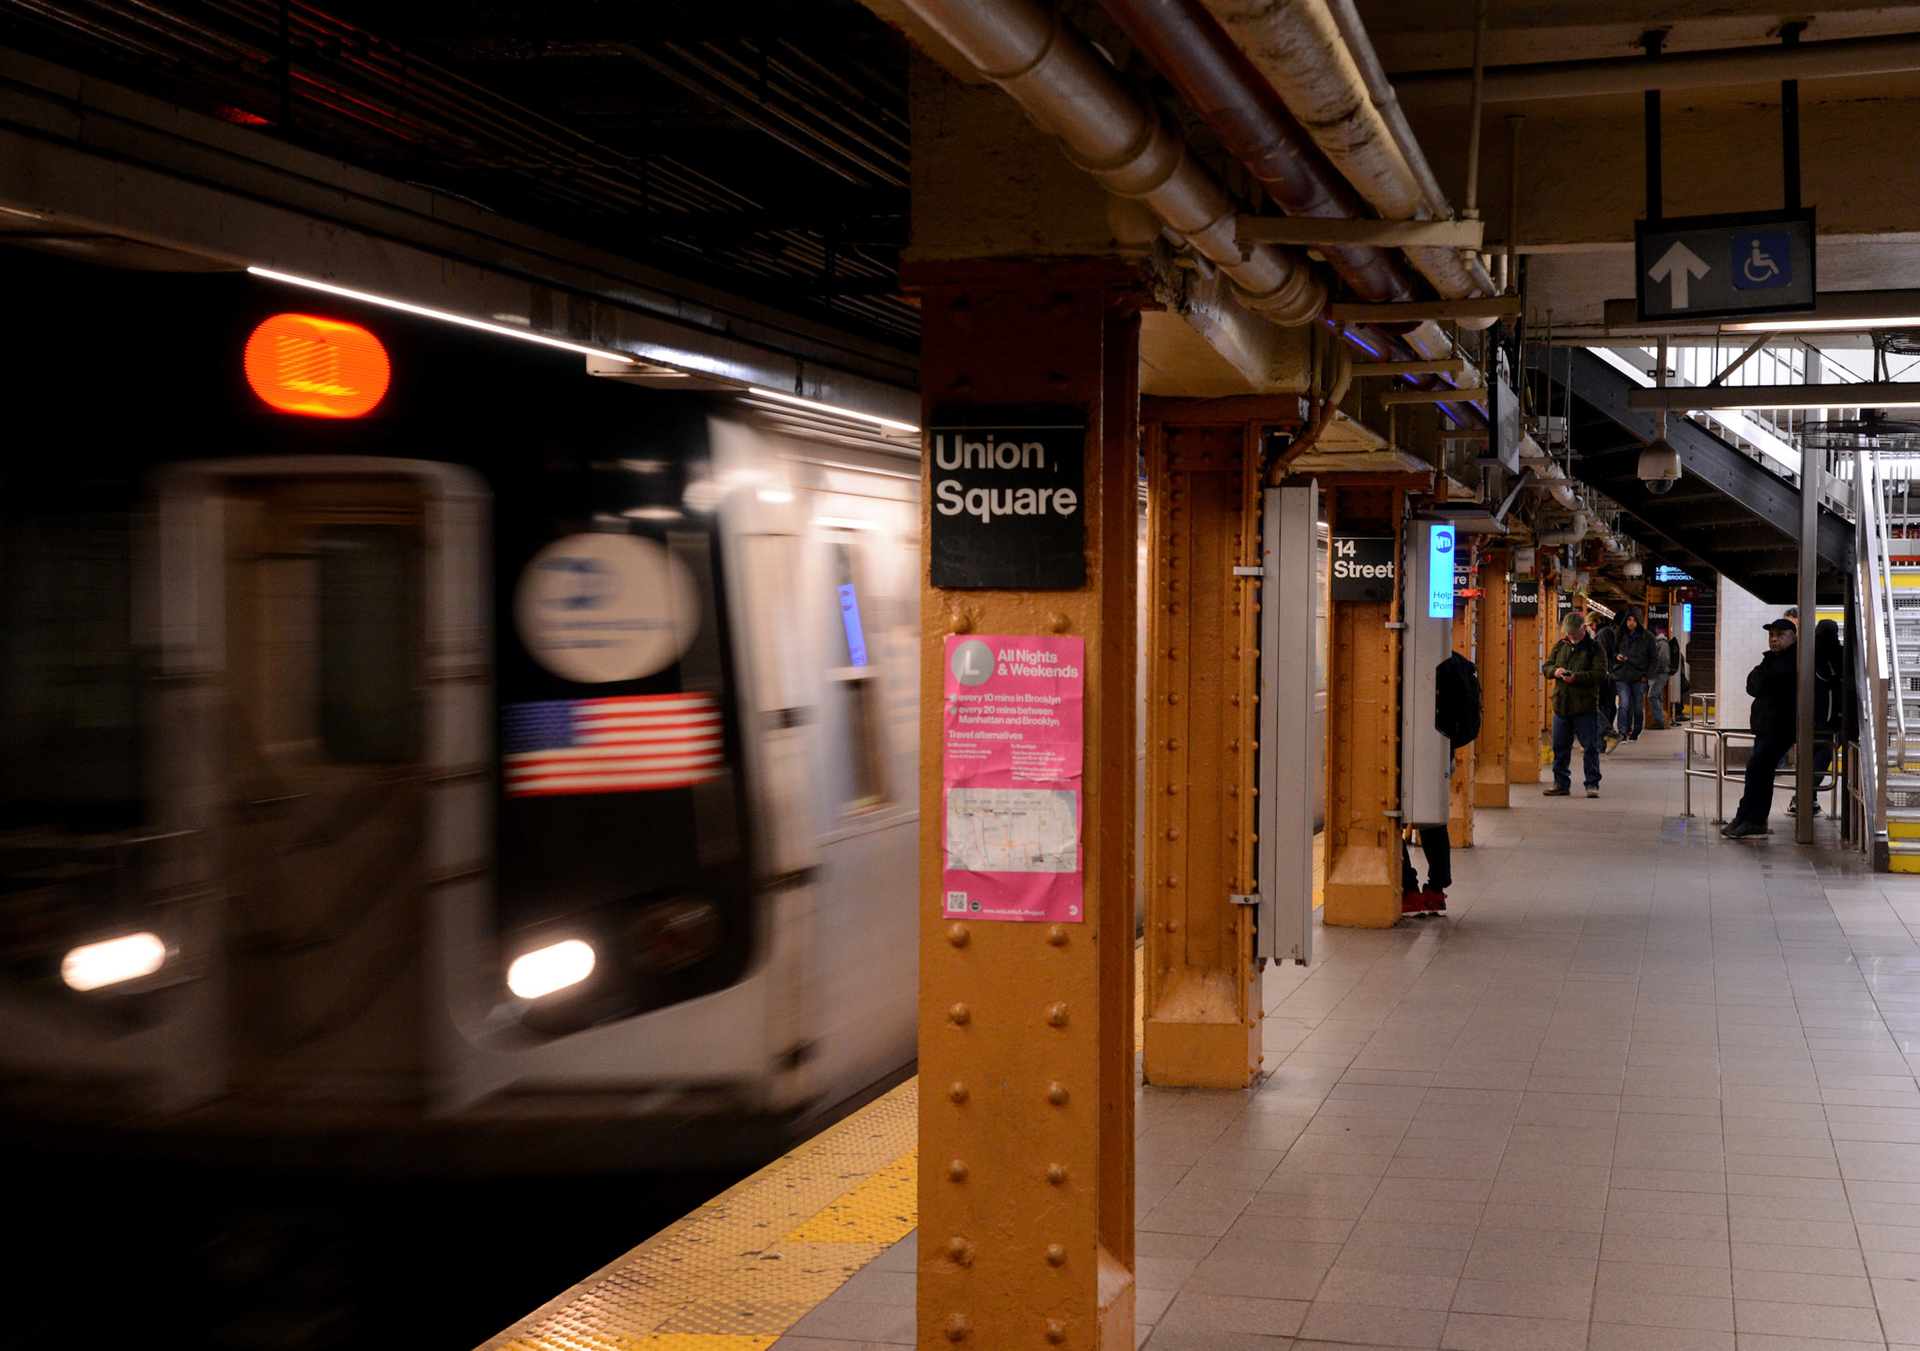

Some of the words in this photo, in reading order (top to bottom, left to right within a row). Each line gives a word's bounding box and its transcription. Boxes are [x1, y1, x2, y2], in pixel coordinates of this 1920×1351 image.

[935, 434, 1045, 470] Union
[936, 479, 1078, 524] Square
[1334, 540, 1356, 557] 14
[1334, 560, 1394, 578] Street
[1433, 591, 1452, 600] Help
[964, 650, 980, 676] L
[997, 649, 1015, 662] All
[1016, 650, 1058, 665] Nights
[997, 664, 1008, 676] &
[1010, 664, 1079, 678] Weekends
[958, 695, 982, 704] every
[984, 693, 994, 702] 10
[994, 693, 1015, 703] mins
[1016, 694, 1024, 703] in
[1025, 694, 1061, 705] Brooklyn
[958, 706, 982, 715] every
[983, 705, 996, 714] 20
[996, 706, 1017, 715] mins
[1017, 706, 1053, 715] between
[958, 715, 1005, 725] Manhattan
[1005, 716, 1021, 725] and
[1022, 716, 1060, 727] Brooklyn
[948, 731, 974, 740] Travel
[974, 731, 1023, 740] alternatives
